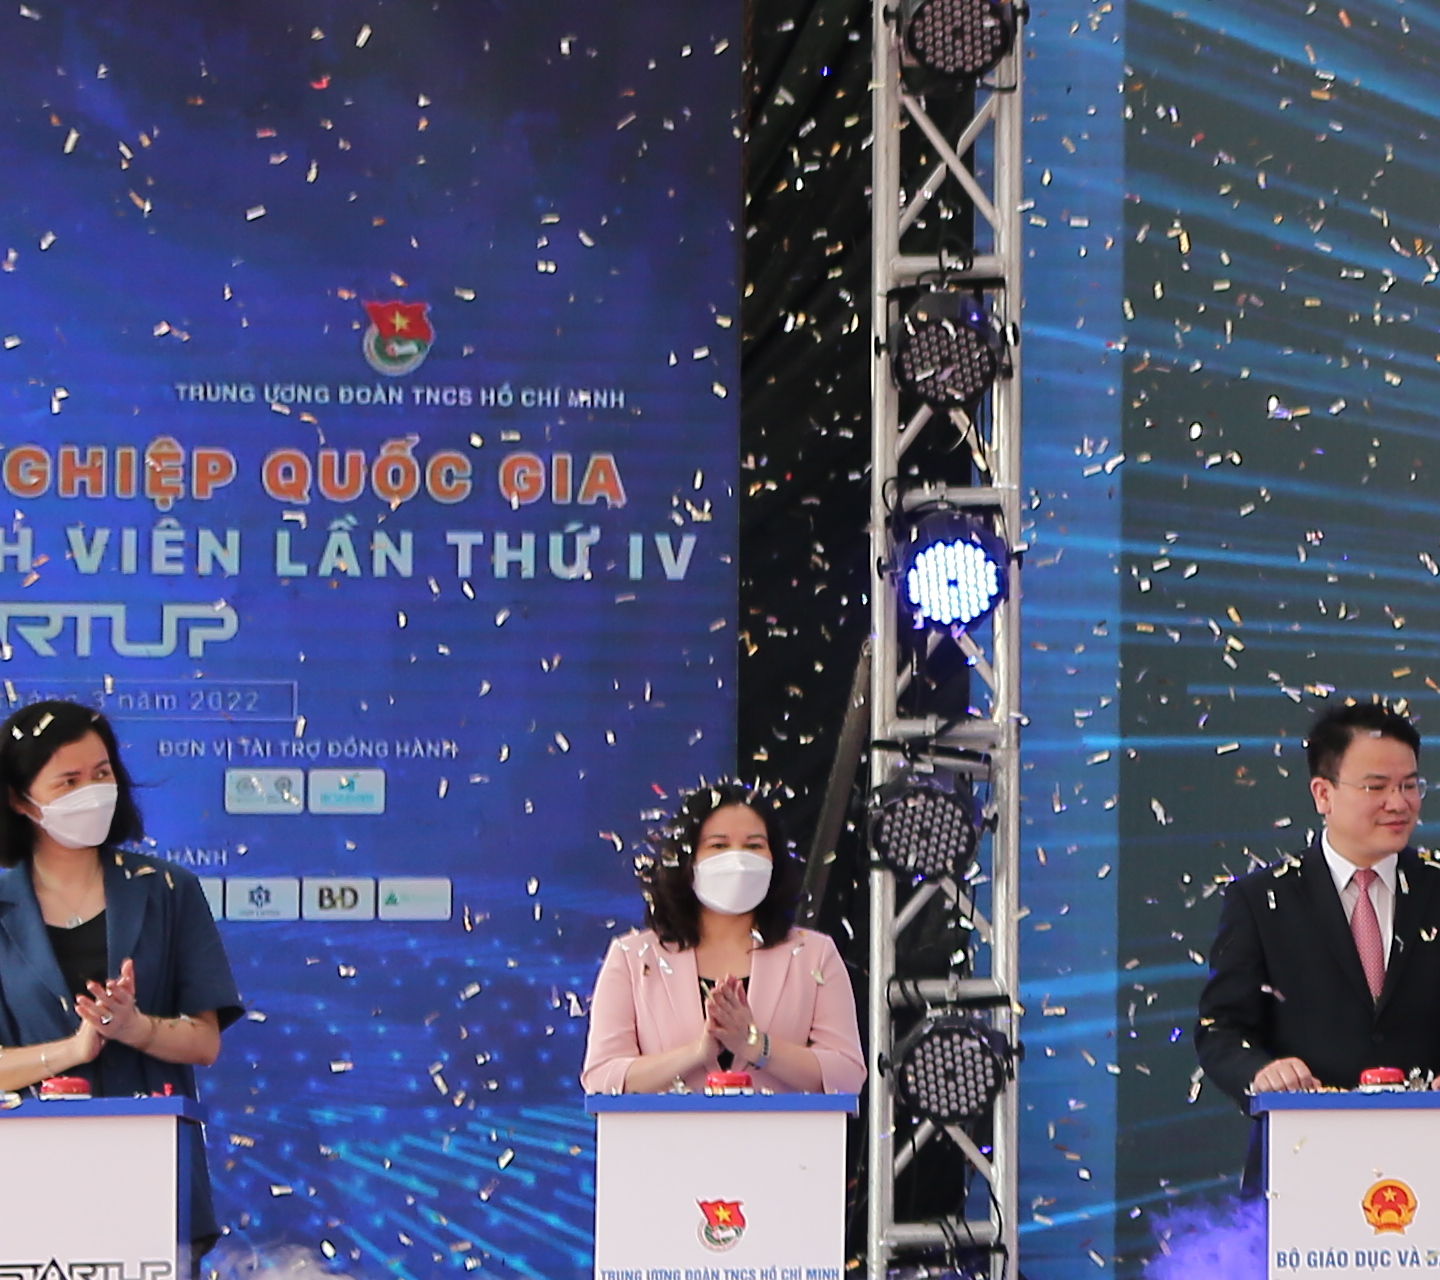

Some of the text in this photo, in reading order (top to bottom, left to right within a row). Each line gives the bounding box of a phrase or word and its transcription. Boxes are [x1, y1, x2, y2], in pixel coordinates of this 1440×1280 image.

[176, 384, 256, 403] TRUNG
[264, 384, 330, 405] ƯƠNG
[338, 383, 404, 406] ĐOÀN
[412, 386, 473, 407] TNCS
[521, 383, 560, 408] CHÍ
[261, 431, 473, 505] QUỐC
[498, 451, 628, 508] GIA
[66, 517, 241, 577] VIÊN
[275, 513, 414, 579] LẦN
[445, 522, 601, 581] THỨ
[628, 532, 698, 582] IV
[190, 691, 260, 712] 2022
[1276, 1246, 1301, 1272] BỘ
[1307, 1246, 1348, 1269] GIÁO
[1355, 1249, 1391, 1272] DỤC
[1399, 1245, 1421, 1268] VÀ
